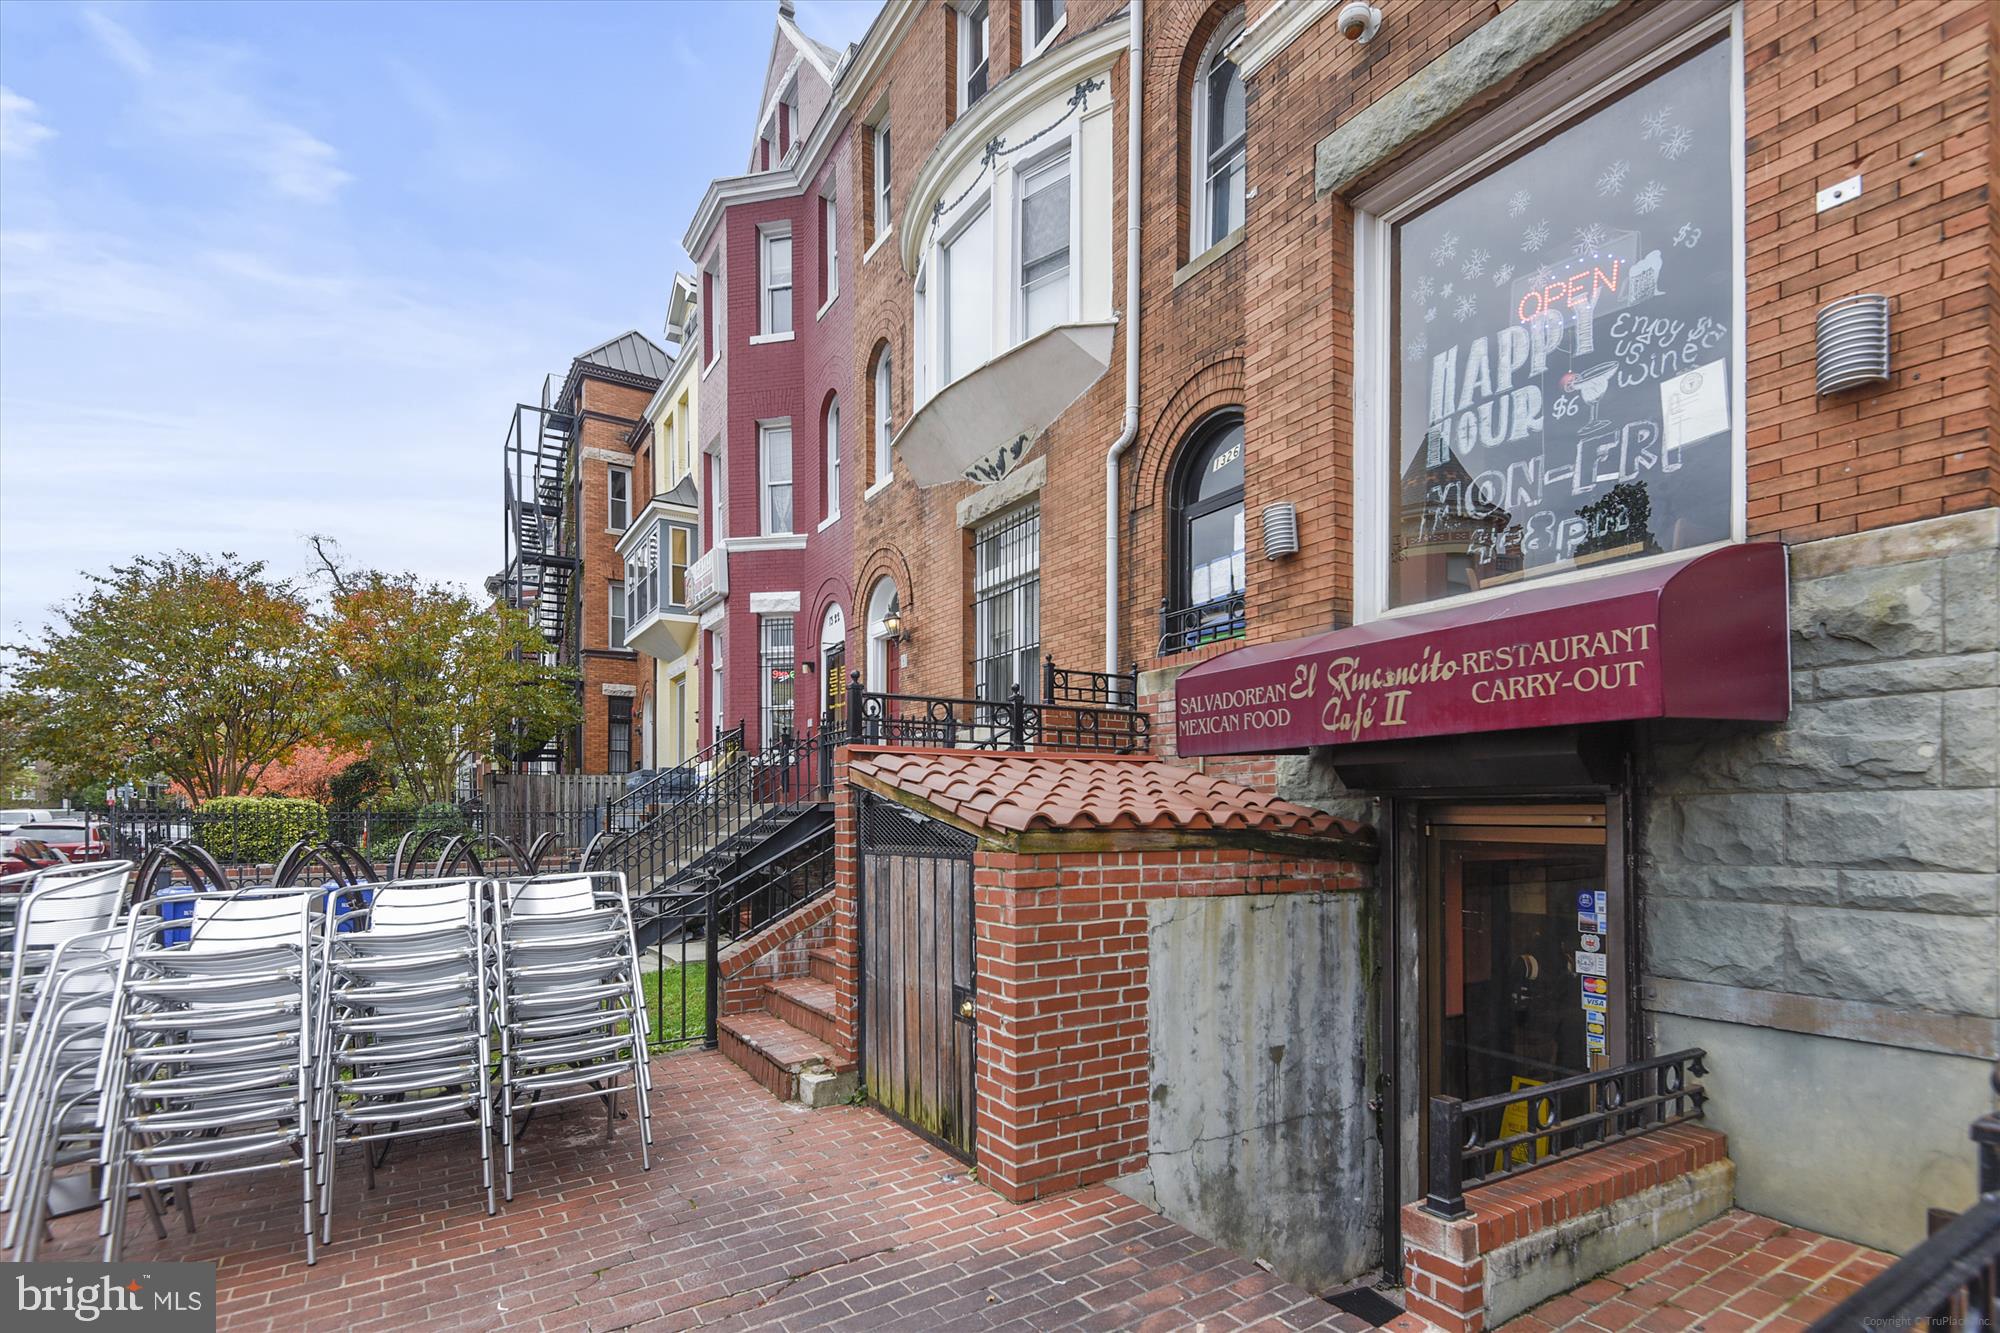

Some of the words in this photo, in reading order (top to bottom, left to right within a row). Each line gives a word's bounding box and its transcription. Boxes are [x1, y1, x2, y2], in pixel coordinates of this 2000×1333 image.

[1673, 222, 1702, 248] $3
[1518, 260, 1618, 323] OPEN
[1610, 312, 1686, 348] Enjoy
[1428, 286, 1603, 425] HAPPY
[1552, 395, 1580, 420] $6
[1425, 384, 1544, 470] HOUR
[1215, 445, 1240, 471] 1326
[1461, 623, 1657, 676] RESTAURANT
[1289, 661, 1318, 700] El
[1471, 660, 1645, 705] CARRY-OUT
[1180, 683, 1288, 716] SALVADOREAN
[1321, 692, 1378, 742] Café
[1380, 690, 1413, 726] II
[1179, 713, 1240, 737] MEXICAN
[1243, 708, 1291, 730] FOOD
[1587, 998, 1605, 1007] VISA
